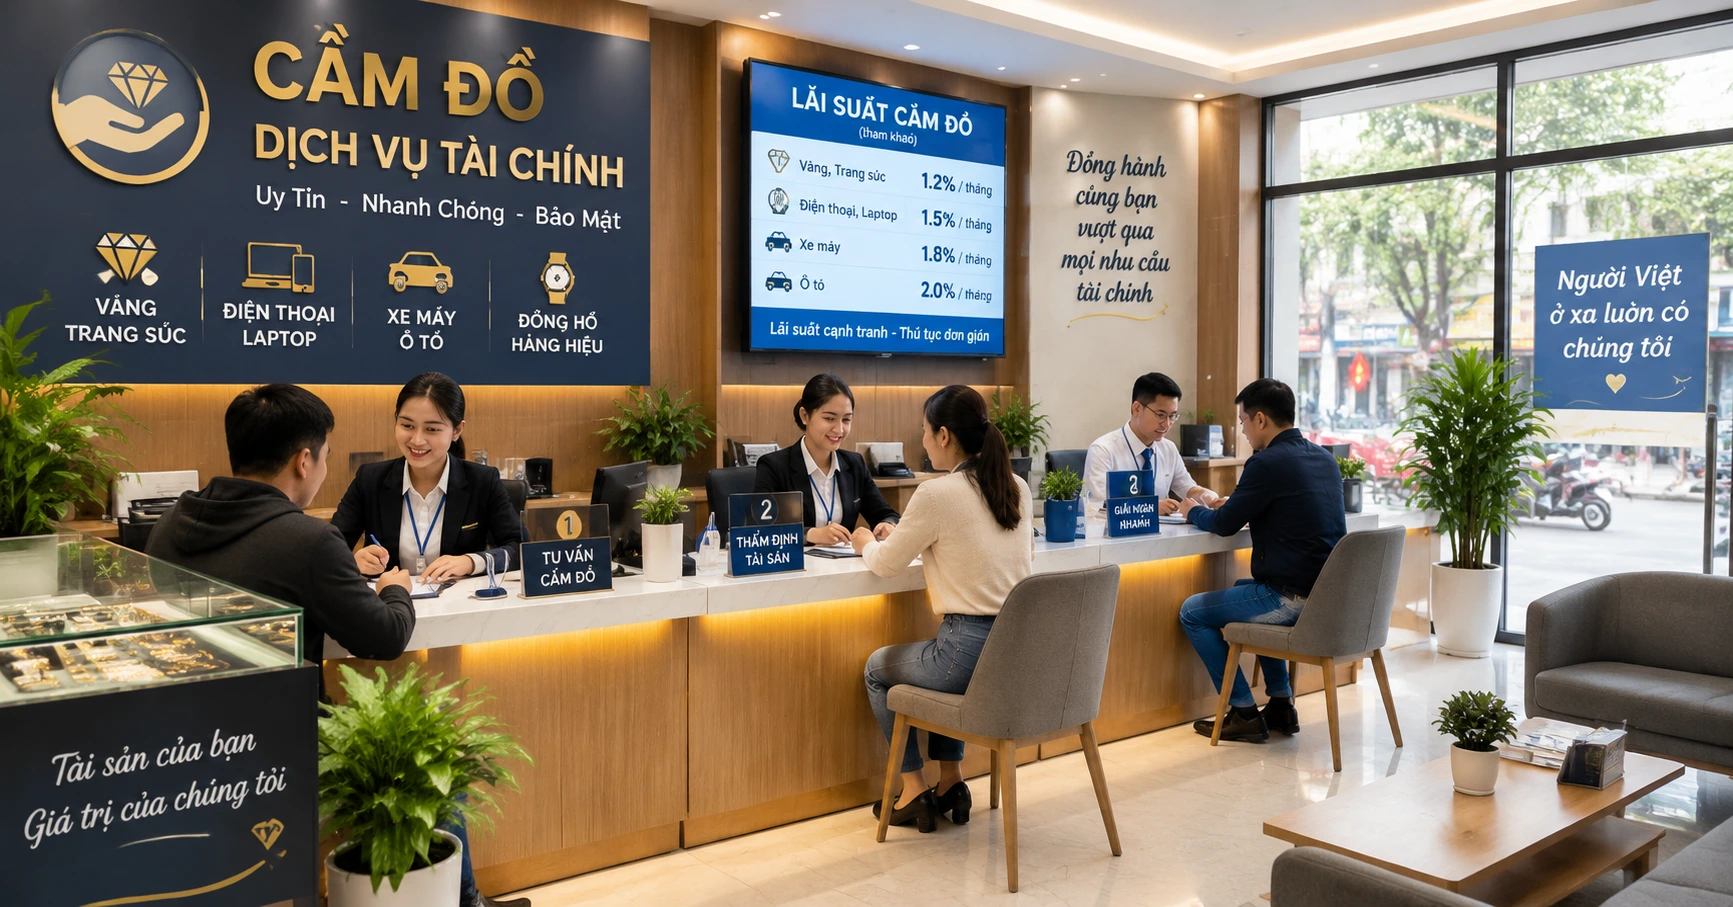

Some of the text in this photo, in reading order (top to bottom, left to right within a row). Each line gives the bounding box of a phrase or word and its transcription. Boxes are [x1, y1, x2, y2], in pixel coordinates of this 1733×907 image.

[254, 23, 543, 120] CẦM ĐỒ
[256, 123, 623, 188] DỊCH VỤ TÀI CHÍNH
[834, 164, 865, 182] Trang
[922, 172, 956, 192] 1.2%
[257, 185, 285, 211] Uy
[363, 193, 430, 216] Nhanh
[1124, 186, 1158, 214] bạn
[862, 206, 897, 223] Laptop
[922, 209, 955, 228] 1.5%
[1078, 219, 1154, 247] vượt qua
[800, 238, 814, 251] Xe
[922, 245, 955, 263] 1.8%
[1061, 250, 1095, 276] mọi
[1099, 249, 1135, 271] nhu
[921, 281, 955, 299] 2.0%
[1558, 266, 1626, 296] Người
[222, 300, 334, 326] ĐIỆN THOẠI
[387, 308, 410, 324] XE
[1570, 309, 1597, 324] xa
[1661, 299, 1689, 322] có
[65, 325, 138, 342] TRANG
[243, 330, 316, 347] LAPTOP
[856, 325, 888, 338] tranh
[761, 499, 772, 520] 2
[564, 515, 573, 536] 1
[52, 729, 257, 786] Tài sản của bạn
[24, 806, 74, 849] Giá
[121, 791, 168, 821] của
